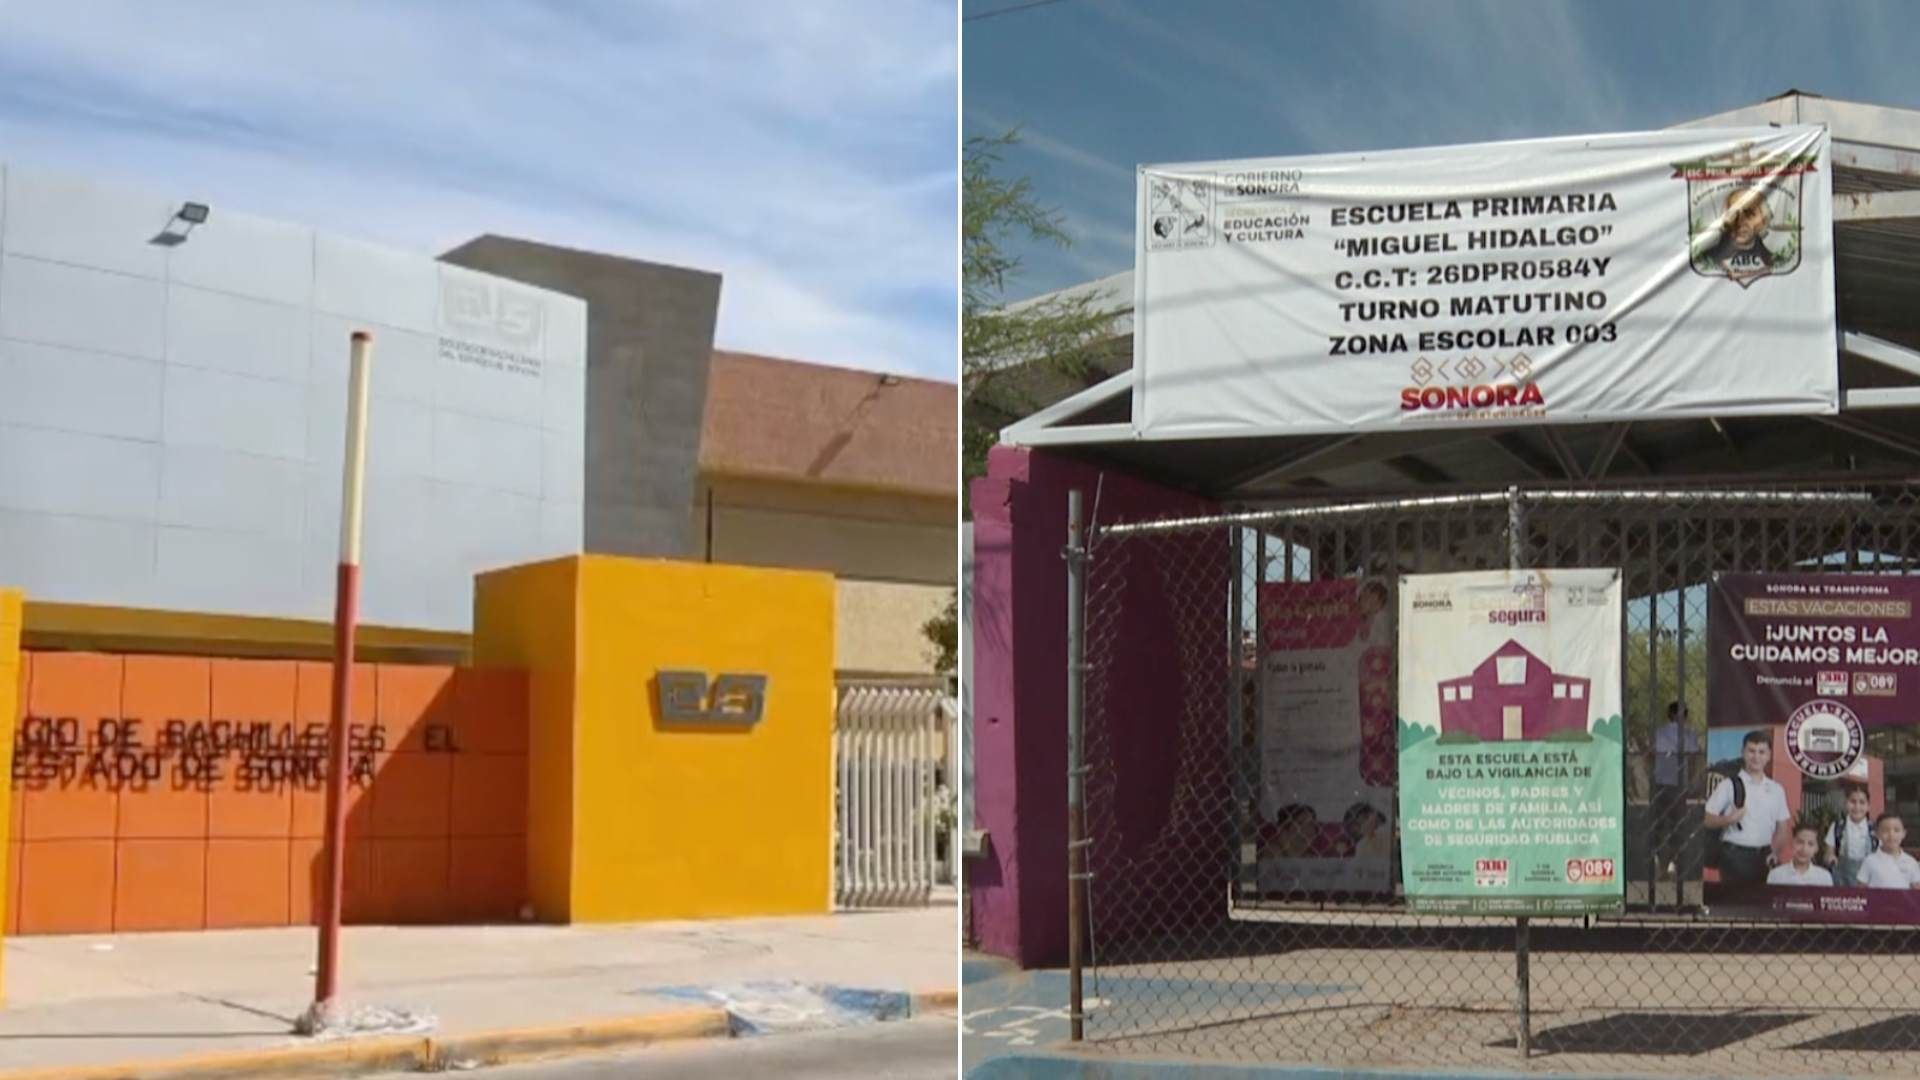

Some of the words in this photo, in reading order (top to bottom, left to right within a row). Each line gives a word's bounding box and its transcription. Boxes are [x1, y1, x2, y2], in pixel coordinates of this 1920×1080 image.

[1224, 170, 1303, 184] GOBIERNO
[1236, 182, 1301, 197] SONORA
[1330, 200, 1462, 227] ESCUELA
[1472, 192, 1617, 218] PRIMARIA
[1223, 213, 1310, 230] EDUCACIÓN
[1224, 232, 1233, 243] Y
[1237, 228, 1305, 242] CULTURA
[1334, 232, 1458, 258] “MIGUEL
[1467, 225, 1613, 250] HIDALGO”
[1730, 255, 1760, 267] ABC
[1335, 267, 1417, 290] C.C.T:
[1427, 257, 1611, 285] 26DPR0584Y
[1339, 298, 1440, 322] TURNO
[1450, 290, 1607, 317] MATUTINO
[1329, 332, 1408, 356] ZONA
[1419, 325, 1555, 352] ESCOLAR
[1565, 321, 1617, 345] 003
[1401, 381, 1545, 411] SONORA
[1766, 584, 1806, 593] SONORA
[1809, 585, 1820, 594] SE
[1824, 585, 1889, 595] TRANSFORMA
[1751, 601, 1799, 615] ESTAS
[1801, 600, 1906, 616] VACACIONES
[1489, 609, 1546, 626] segura
[1766, 624, 1856, 642] ¡JUNTOS
[1862, 626, 1888, 643] LA
[1730, 644, 1840, 663] CUIDAMOS
[1846, 647, 1920, 666] MEJOR
[1756, 674, 1801, 686] Denuncia
[1804, 676, 1813, 686] al
[1870, 675, 1894, 689] 089
[98, 719, 142, 748] DE
[1439, 754, 1471, 766] ESTA
[1476, 753, 1539, 765] ESCUELA
[1544, 749, 1578, 764] ESTÁ
[181, 752, 224, 781] DE
[1426, 768, 1462, 781] BAJO
[1467, 768, 1483, 779] LA
[1488, 767, 1568, 779] VIGILANCIA
[1573, 766, 1592, 778] DE
[1439, 786, 1505, 800] VECINOS,
[1511, 786, 1569, 798] PADRES
[1574, 786, 1584, 797] Y
[1421, 803, 1480, 815] MADRES
[1486, 803, 1504, 814] DE
[1510, 802, 1573, 815] FAMILIA,
[1578, 798, 1602, 814] ASÍ
[1408, 818, 1451, 830] COMO
[1455, 818, 1474, 830] DE
[1479, 818, 1505, 830] LAS
[1511, 817, 1617, 830] AUTORIDADES
[1424, 834, 1442, 846] DE
[1448, 833, 1530, 846] SEGURIDAD
[1585, 860, 1613, 876] 089
